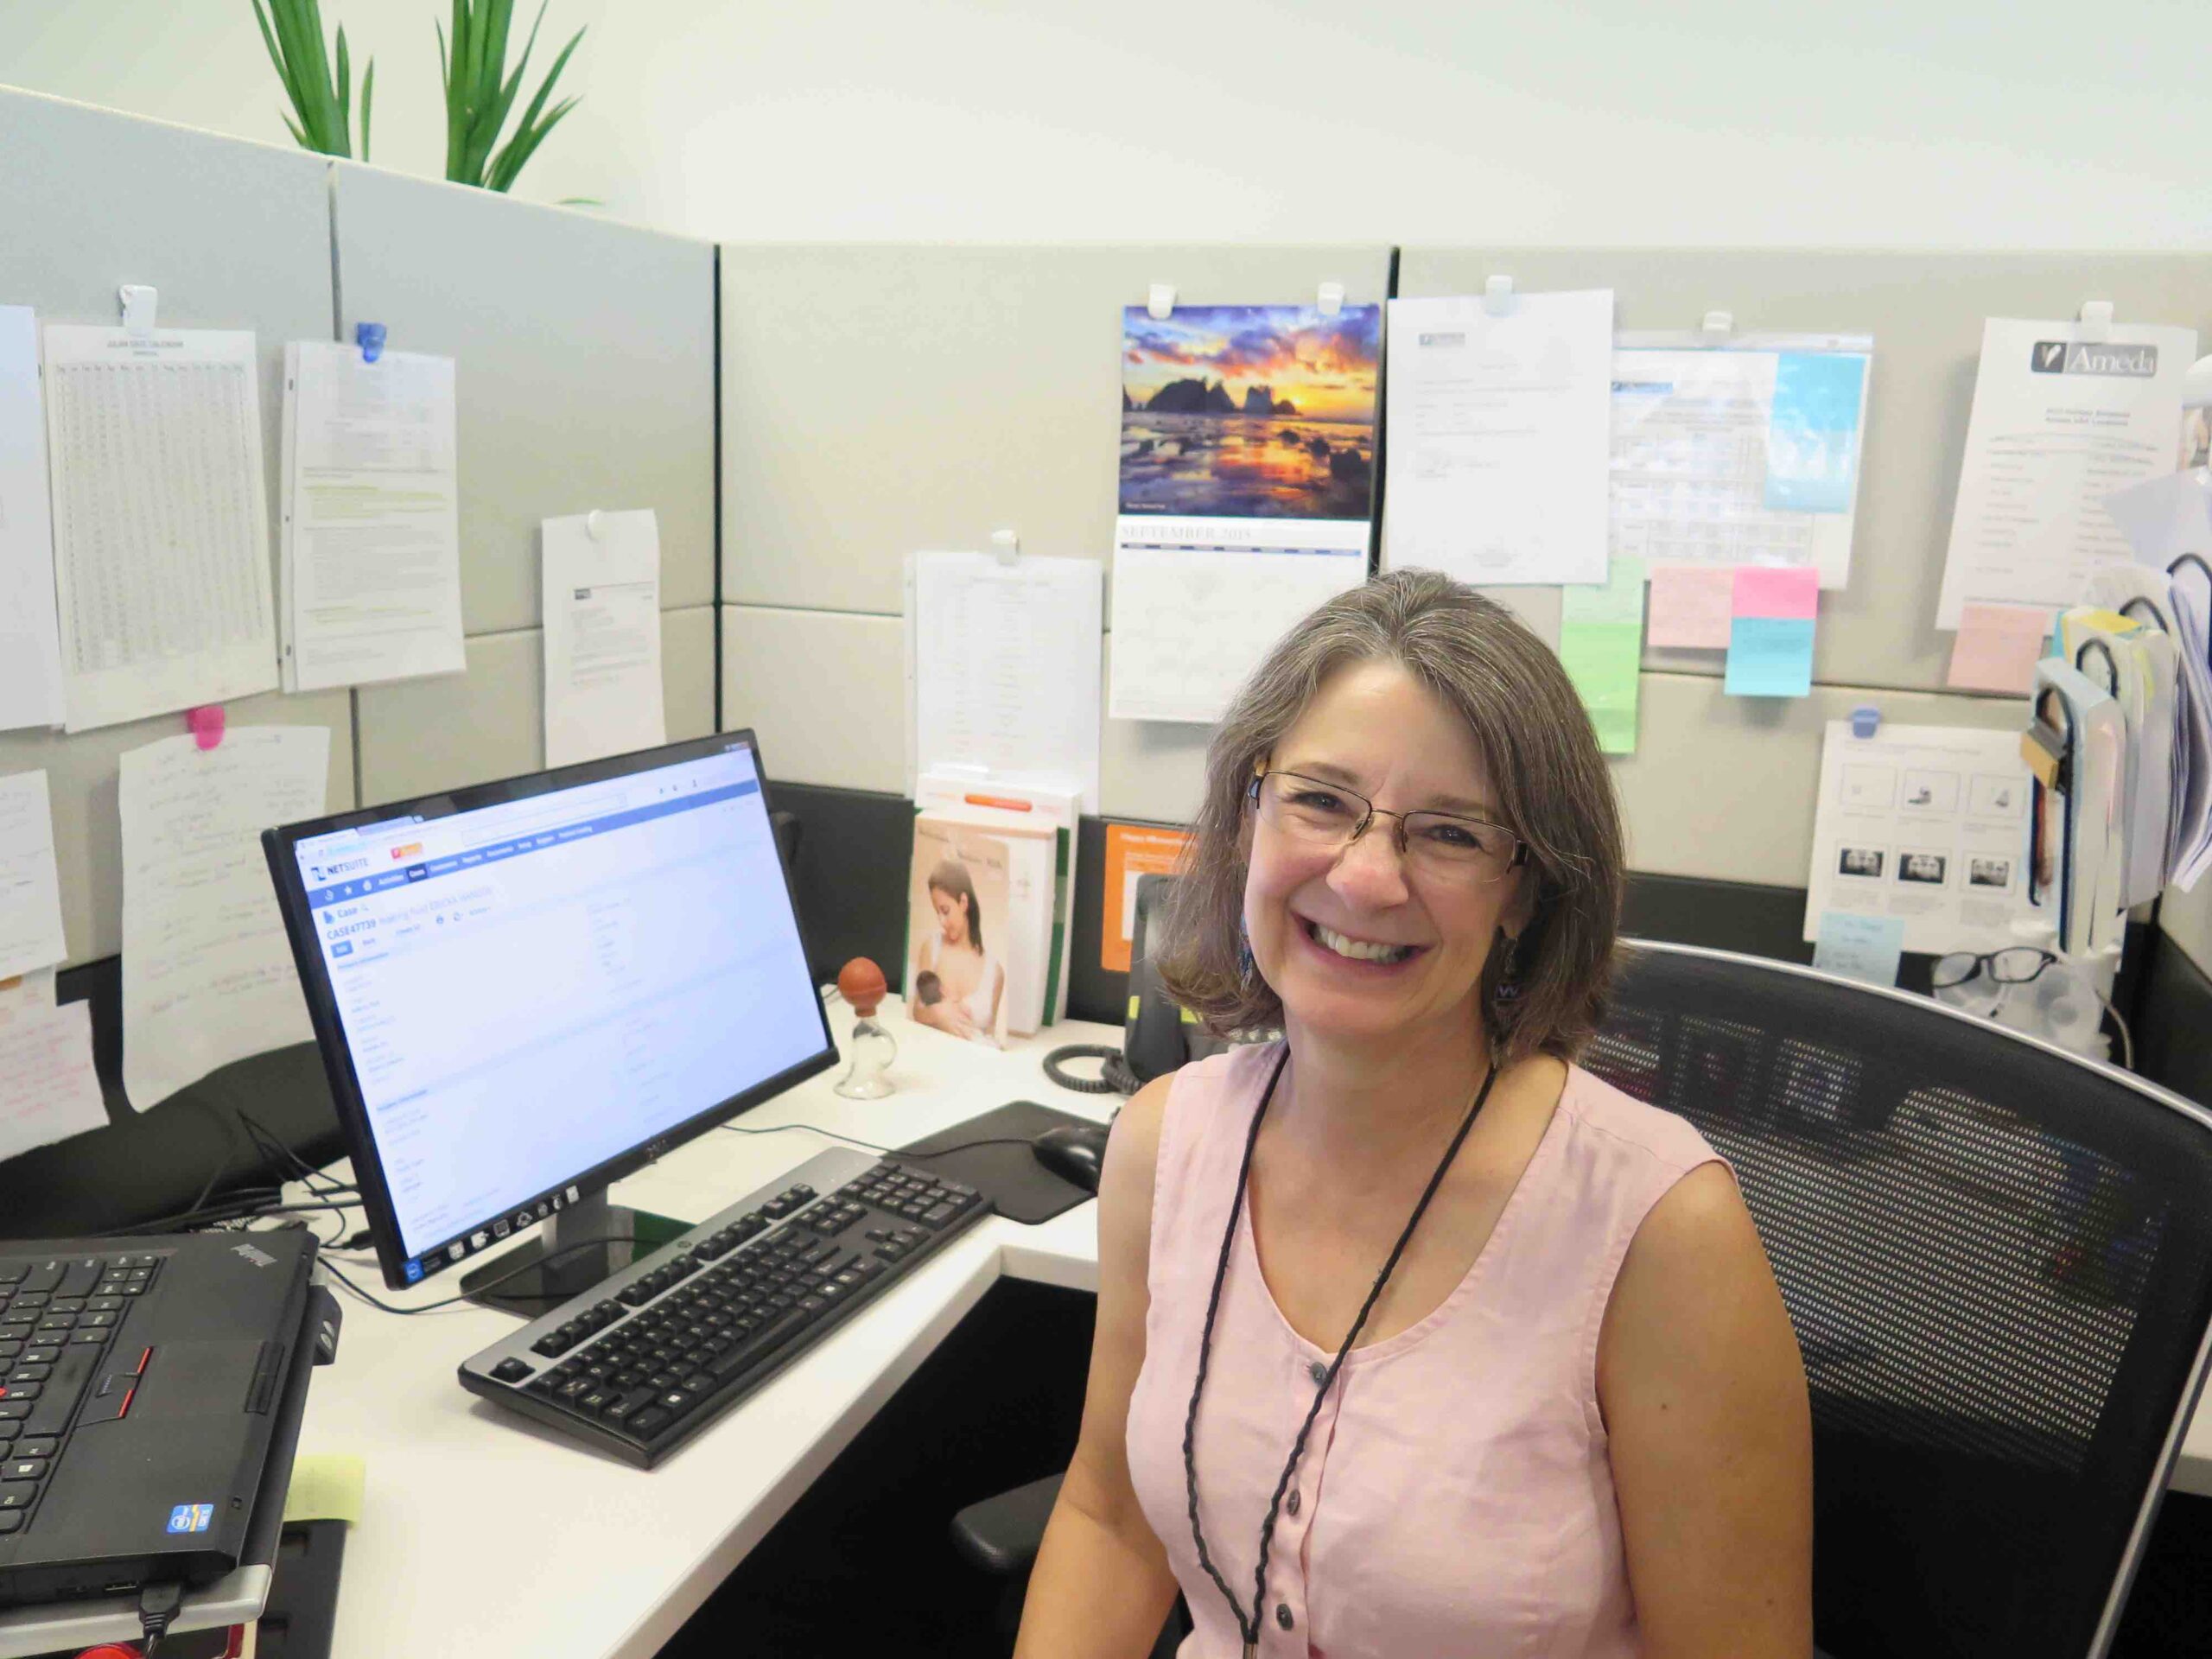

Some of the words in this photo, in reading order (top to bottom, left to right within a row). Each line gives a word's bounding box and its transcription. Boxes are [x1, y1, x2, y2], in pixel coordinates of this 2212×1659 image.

[2069, 346, 2157, 373] Ameda
[1121, 525, 1216, 540] SEPTEMBER
[327, 857, 369, 875] NETSUITE
